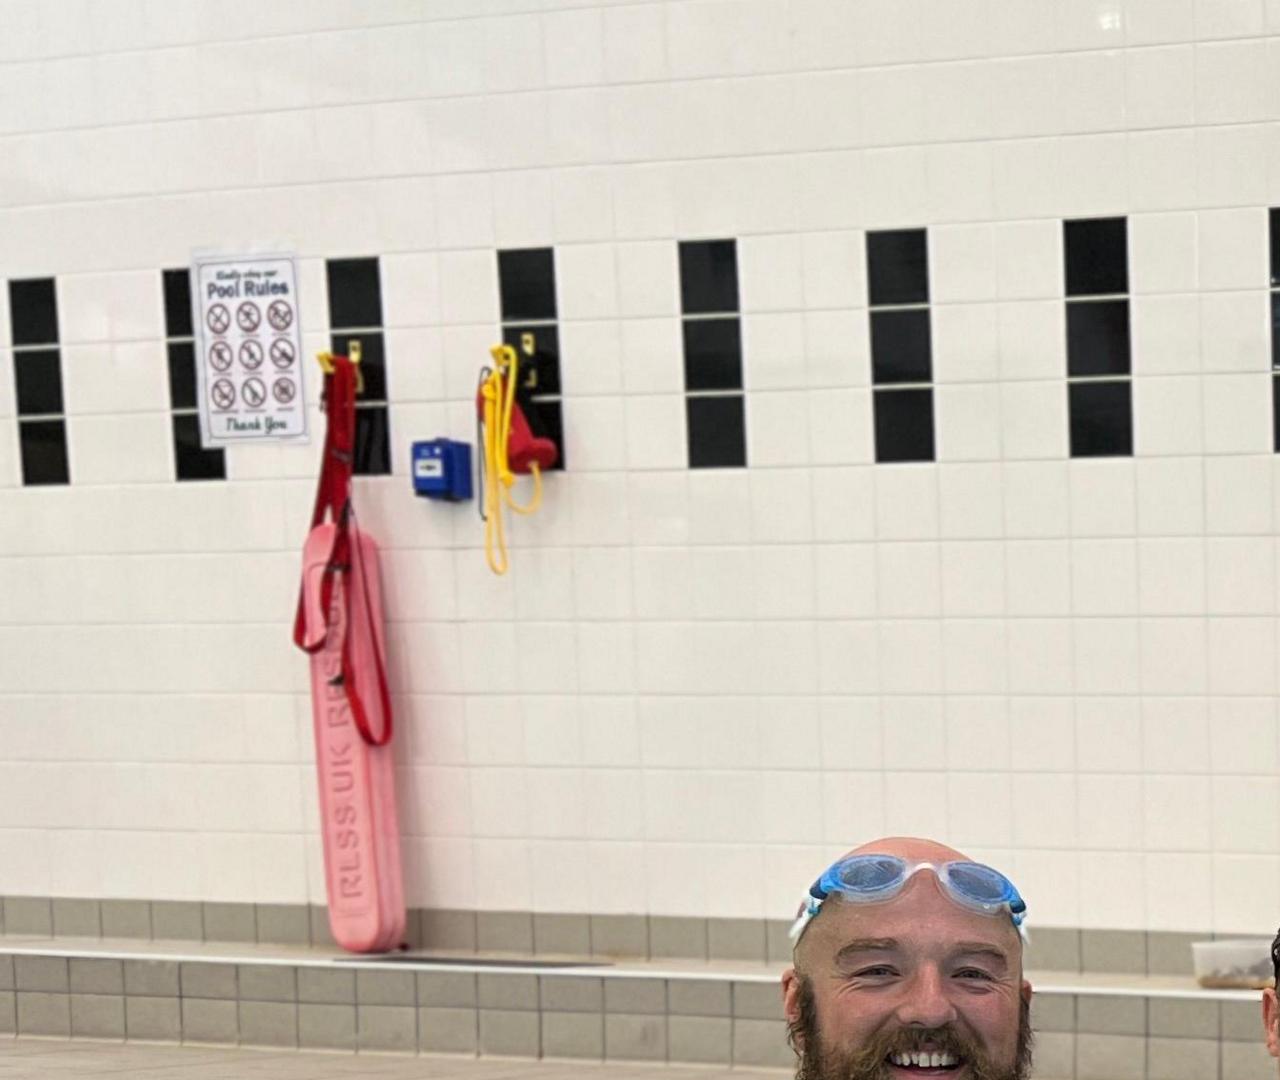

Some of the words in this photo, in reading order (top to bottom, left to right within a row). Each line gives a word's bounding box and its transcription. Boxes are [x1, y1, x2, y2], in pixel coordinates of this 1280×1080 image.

[207, 279, 240, 300] Pool
[244, 279, 289, 297] Rules
[226, 416, 261, 432] Thank
[264, 416, 287, 435] You
[330, 743, 353, 794] UK
[335, 805, 363, 900] RLSS
